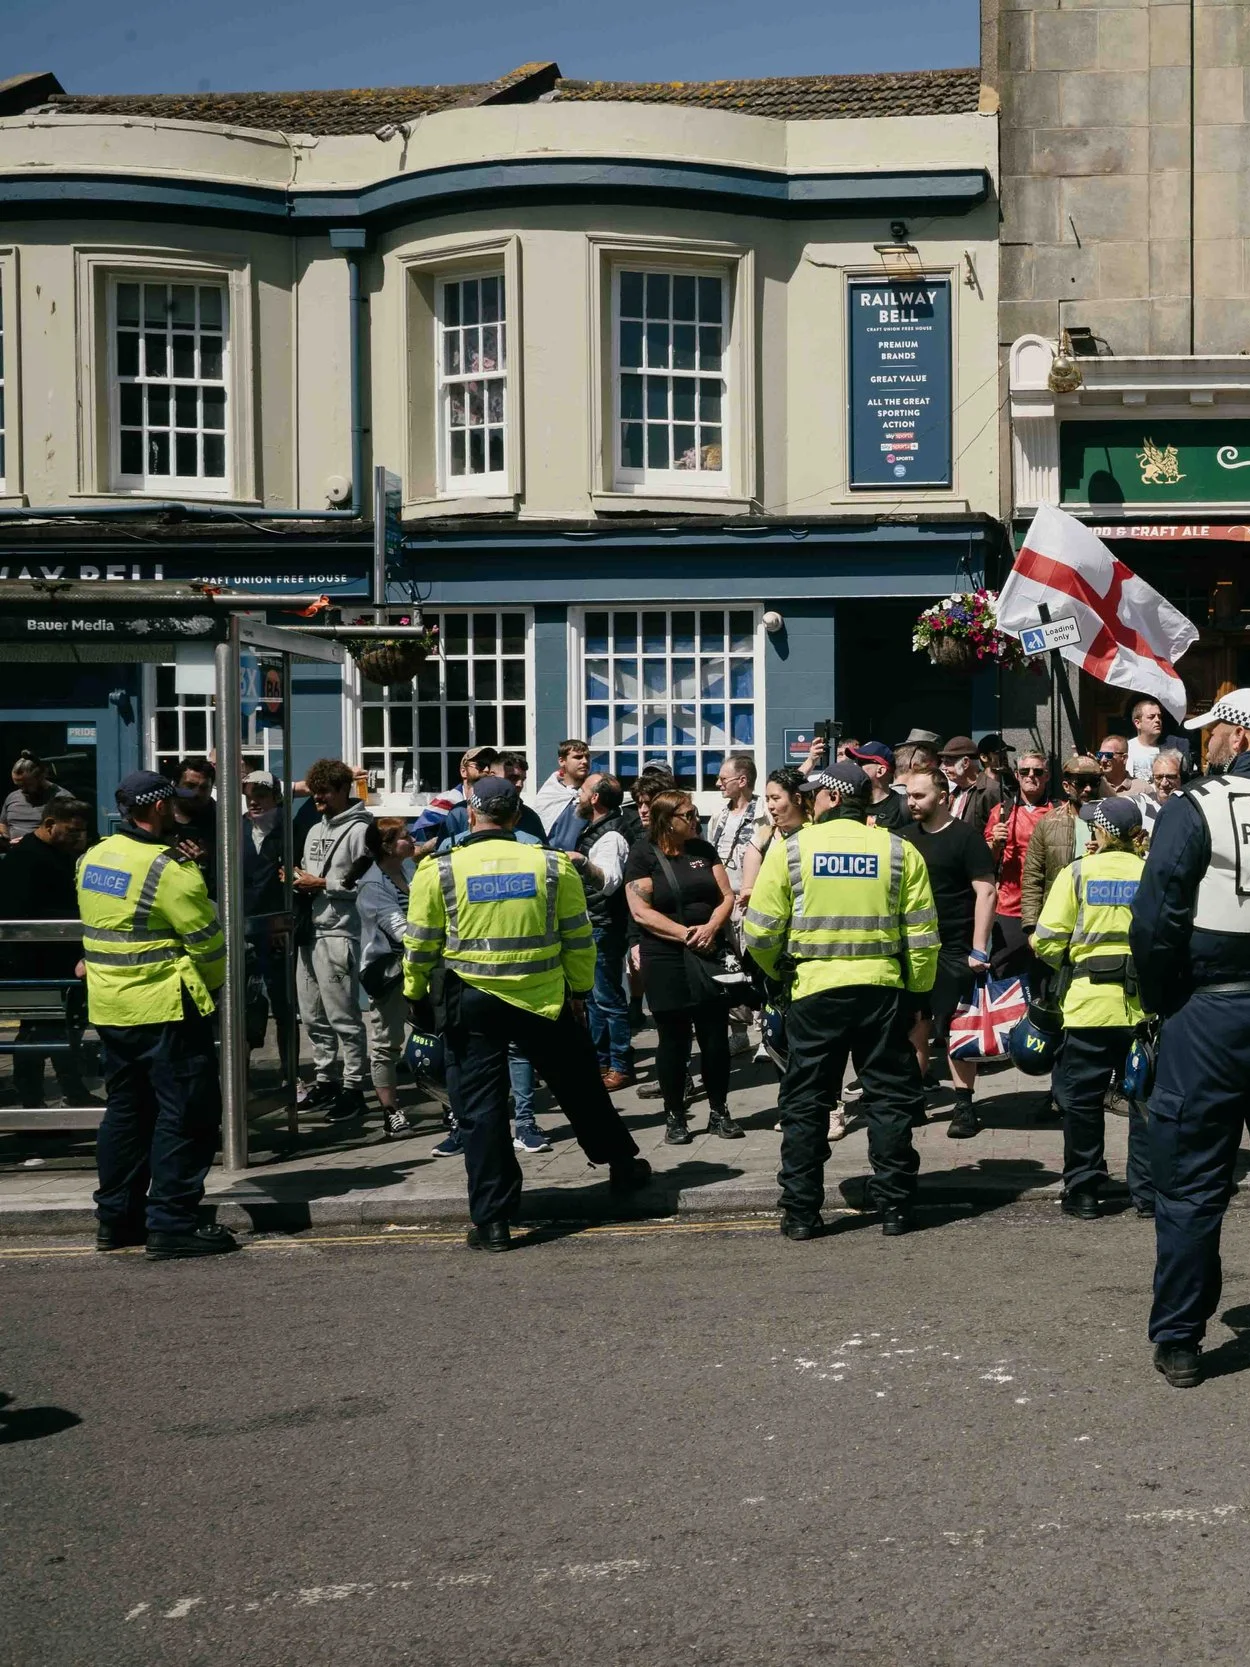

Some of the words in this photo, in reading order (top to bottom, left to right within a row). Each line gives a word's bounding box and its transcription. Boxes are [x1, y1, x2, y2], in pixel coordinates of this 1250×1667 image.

[860, 291, 937, 306] RAILWAY
[879, 309, 919, 323] BELL
[881, 352, 916, 360] BRANDS
[870, 375, 898, 383] GREAT
[899, 374, 927, 382] VALUE
[902, 397, 931, 405] GREAT
[877, 409, 920, 417] SPORTING
[882, 421, 915, 429] ACTION
[1116, 527, 1125, 536] &
[1131, 526, 1178, 536] CRAFT
[1182, 526, 1210, 536] ALE
[234, 576, 272, 584] UNION
[309, 574, 347, 583] HOUSE
[27, 619, 68, 631] Bauer
[71, 619, 115, 631] Media
[1045, 624, 1074, 636] Loading
[1053, 634, 1069, 642] only
[815, 855, 876, 875] POLICE
[85, 871, 126, 890] POLICE
[472, 879, 532, 896] POLICE
